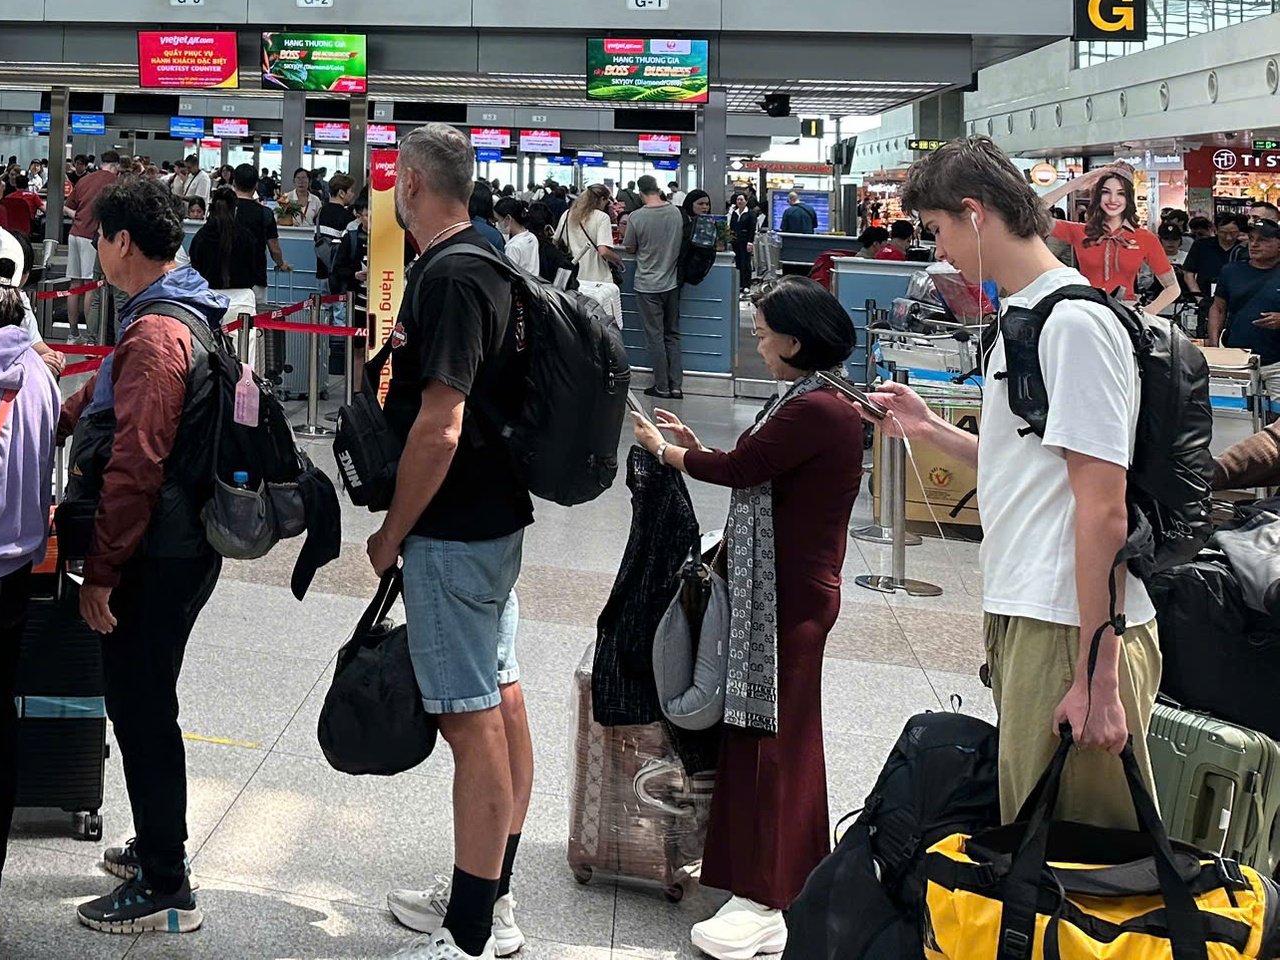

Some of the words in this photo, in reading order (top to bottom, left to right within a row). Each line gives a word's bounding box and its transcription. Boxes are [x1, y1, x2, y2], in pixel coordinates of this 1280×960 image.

[379, 271, 395, 312] Hạng
[354, 327, 369, 336] AC
[338, 450, 363, 488] NIKE
